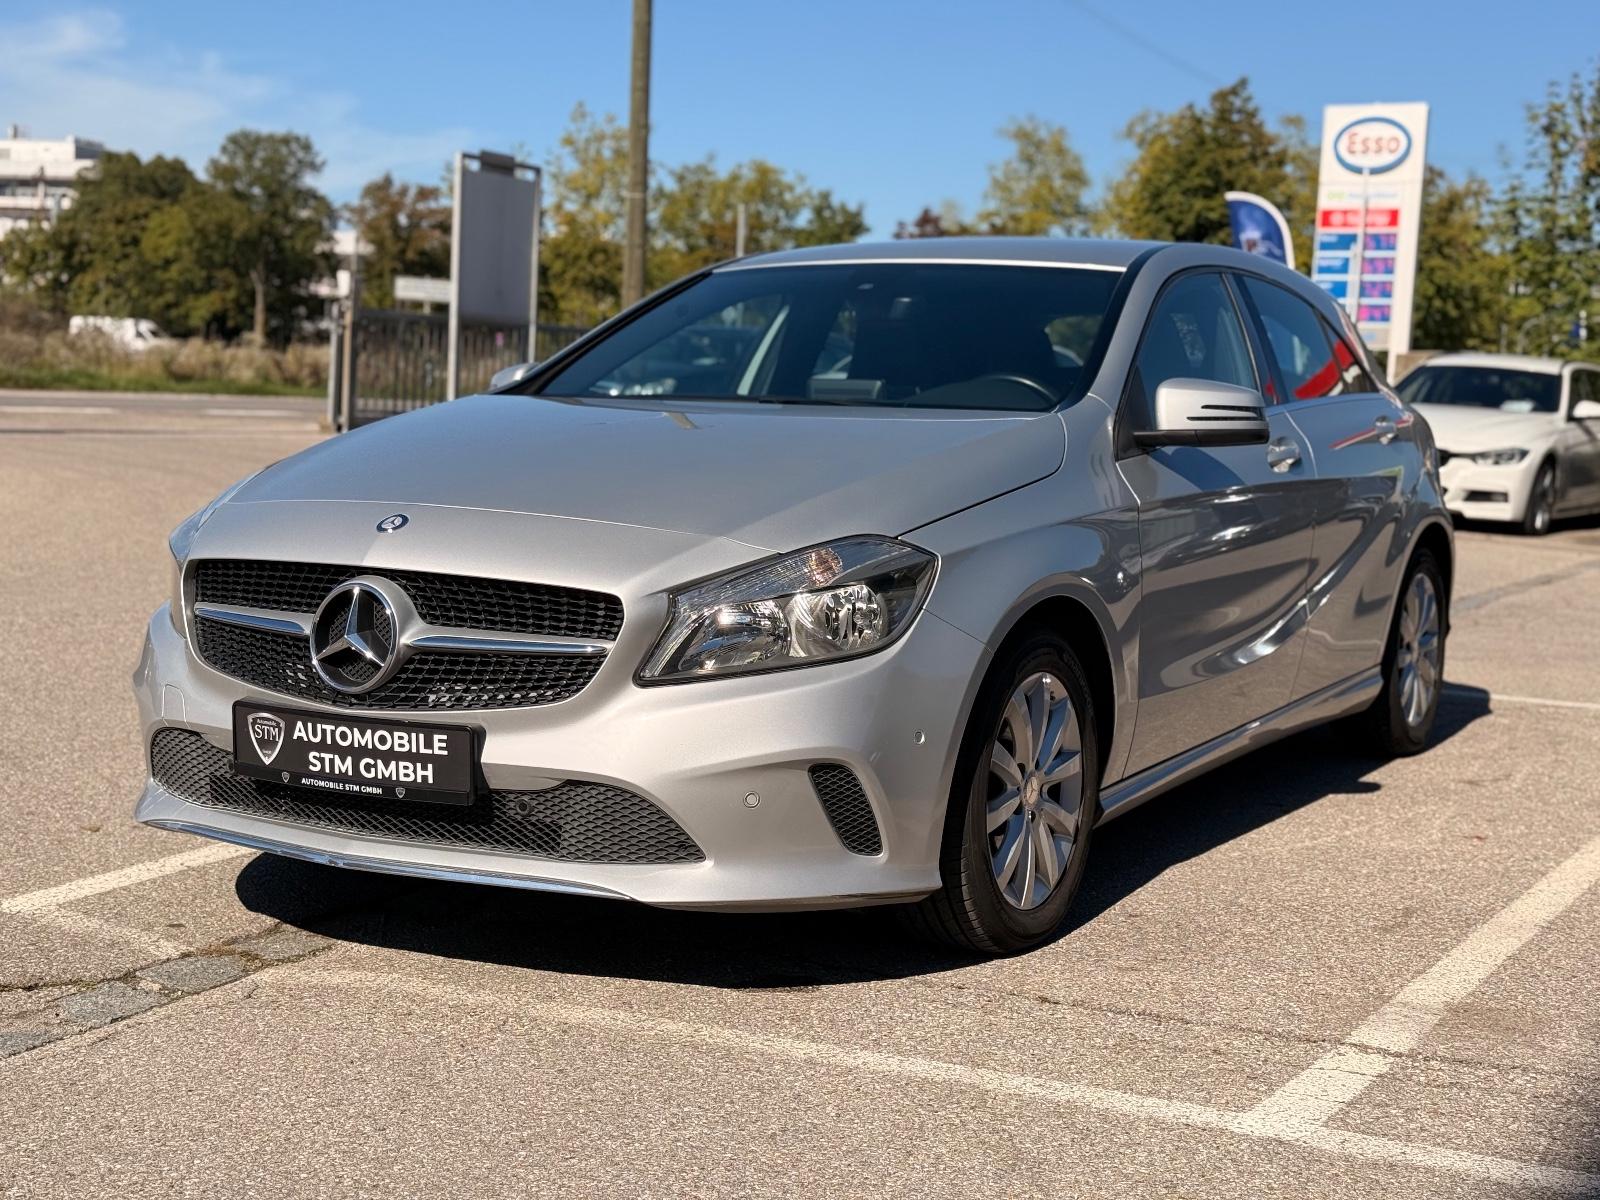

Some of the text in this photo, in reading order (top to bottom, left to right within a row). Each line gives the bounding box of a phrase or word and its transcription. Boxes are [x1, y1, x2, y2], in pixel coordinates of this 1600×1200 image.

[1347, 132, 1401, 155] Esso
[254, 724, 279, 742] STM
[292, 720, 449, 756] AUTOMOBILE
[308, 751, 434, 784] STM GMBH
[301, 777, 383, 795] AUTOMOBILE STM GMBH
